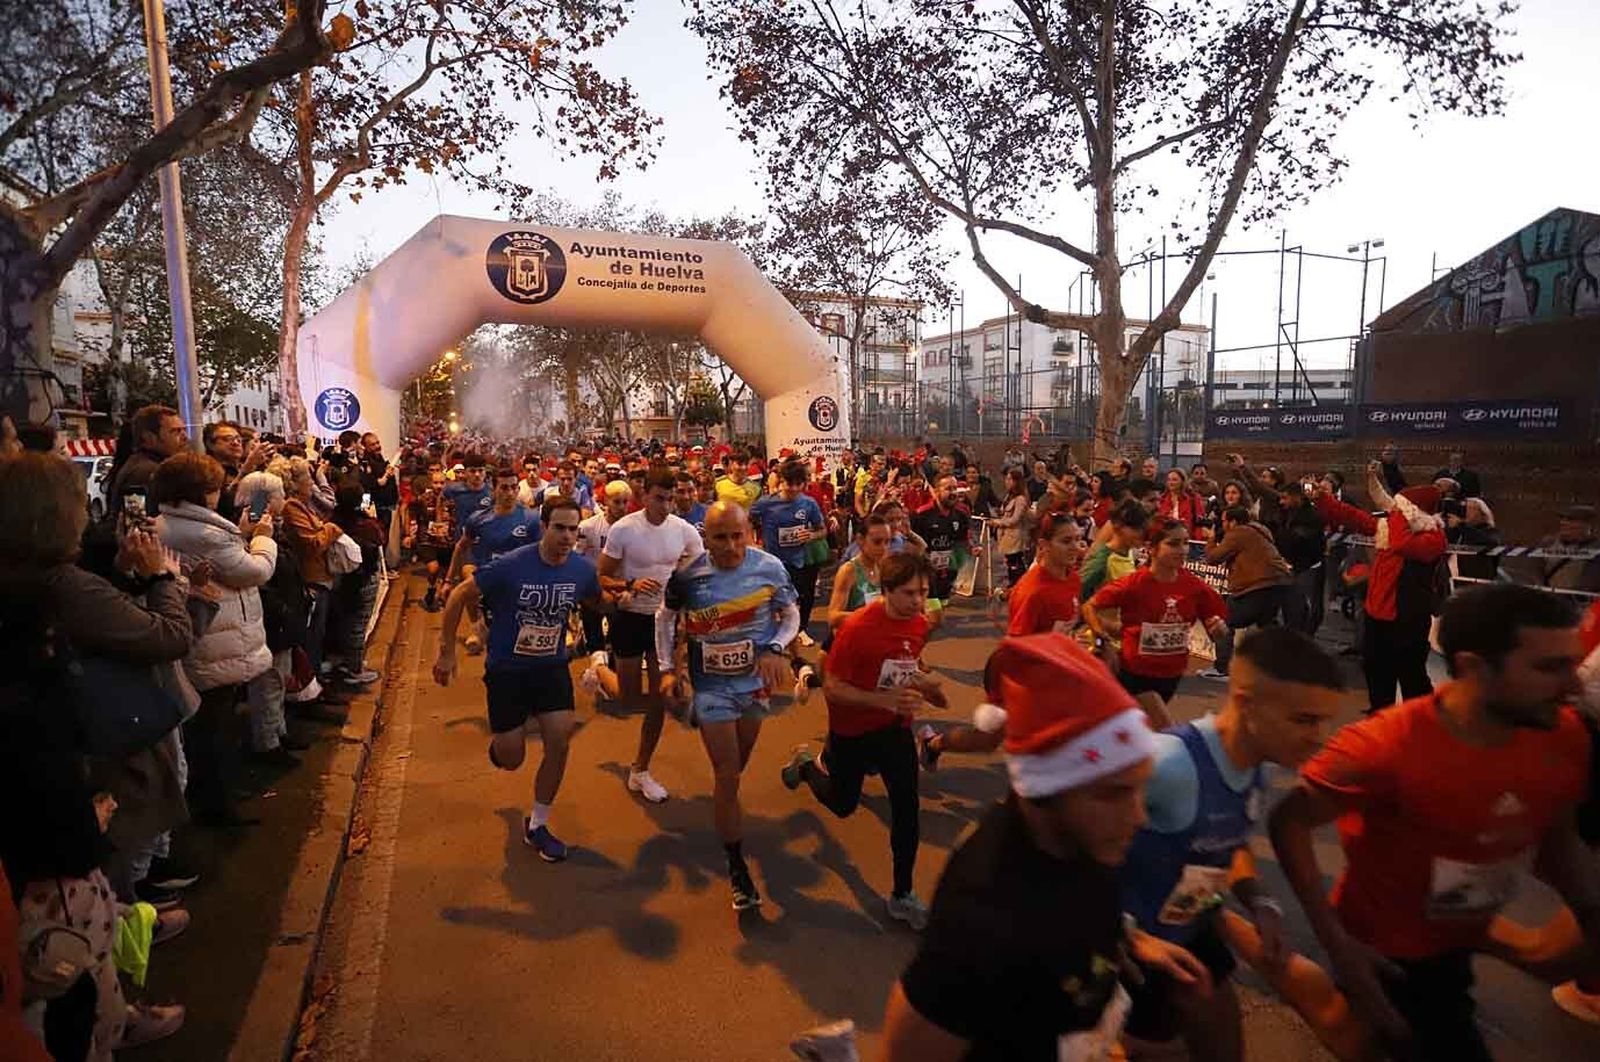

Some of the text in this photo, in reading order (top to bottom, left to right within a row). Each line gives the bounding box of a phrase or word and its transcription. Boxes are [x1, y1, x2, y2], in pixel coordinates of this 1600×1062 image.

[570, 242, 703, 264] Ayuntamiento
[610, 260, 704, 280] de Huelva
[640, 281, 655, 290] de
[657, 282, 706, 293] Deportes
[1299, 413, 1344, 423] HYUNDAI
[1391, 410, 1447, 421] HYUNDAI
[1490, 407, 1559, 419] HYUNDAI
[1231, 416, 1270, 424] HYUNDAI
[722, 651, 749, 666] 629
